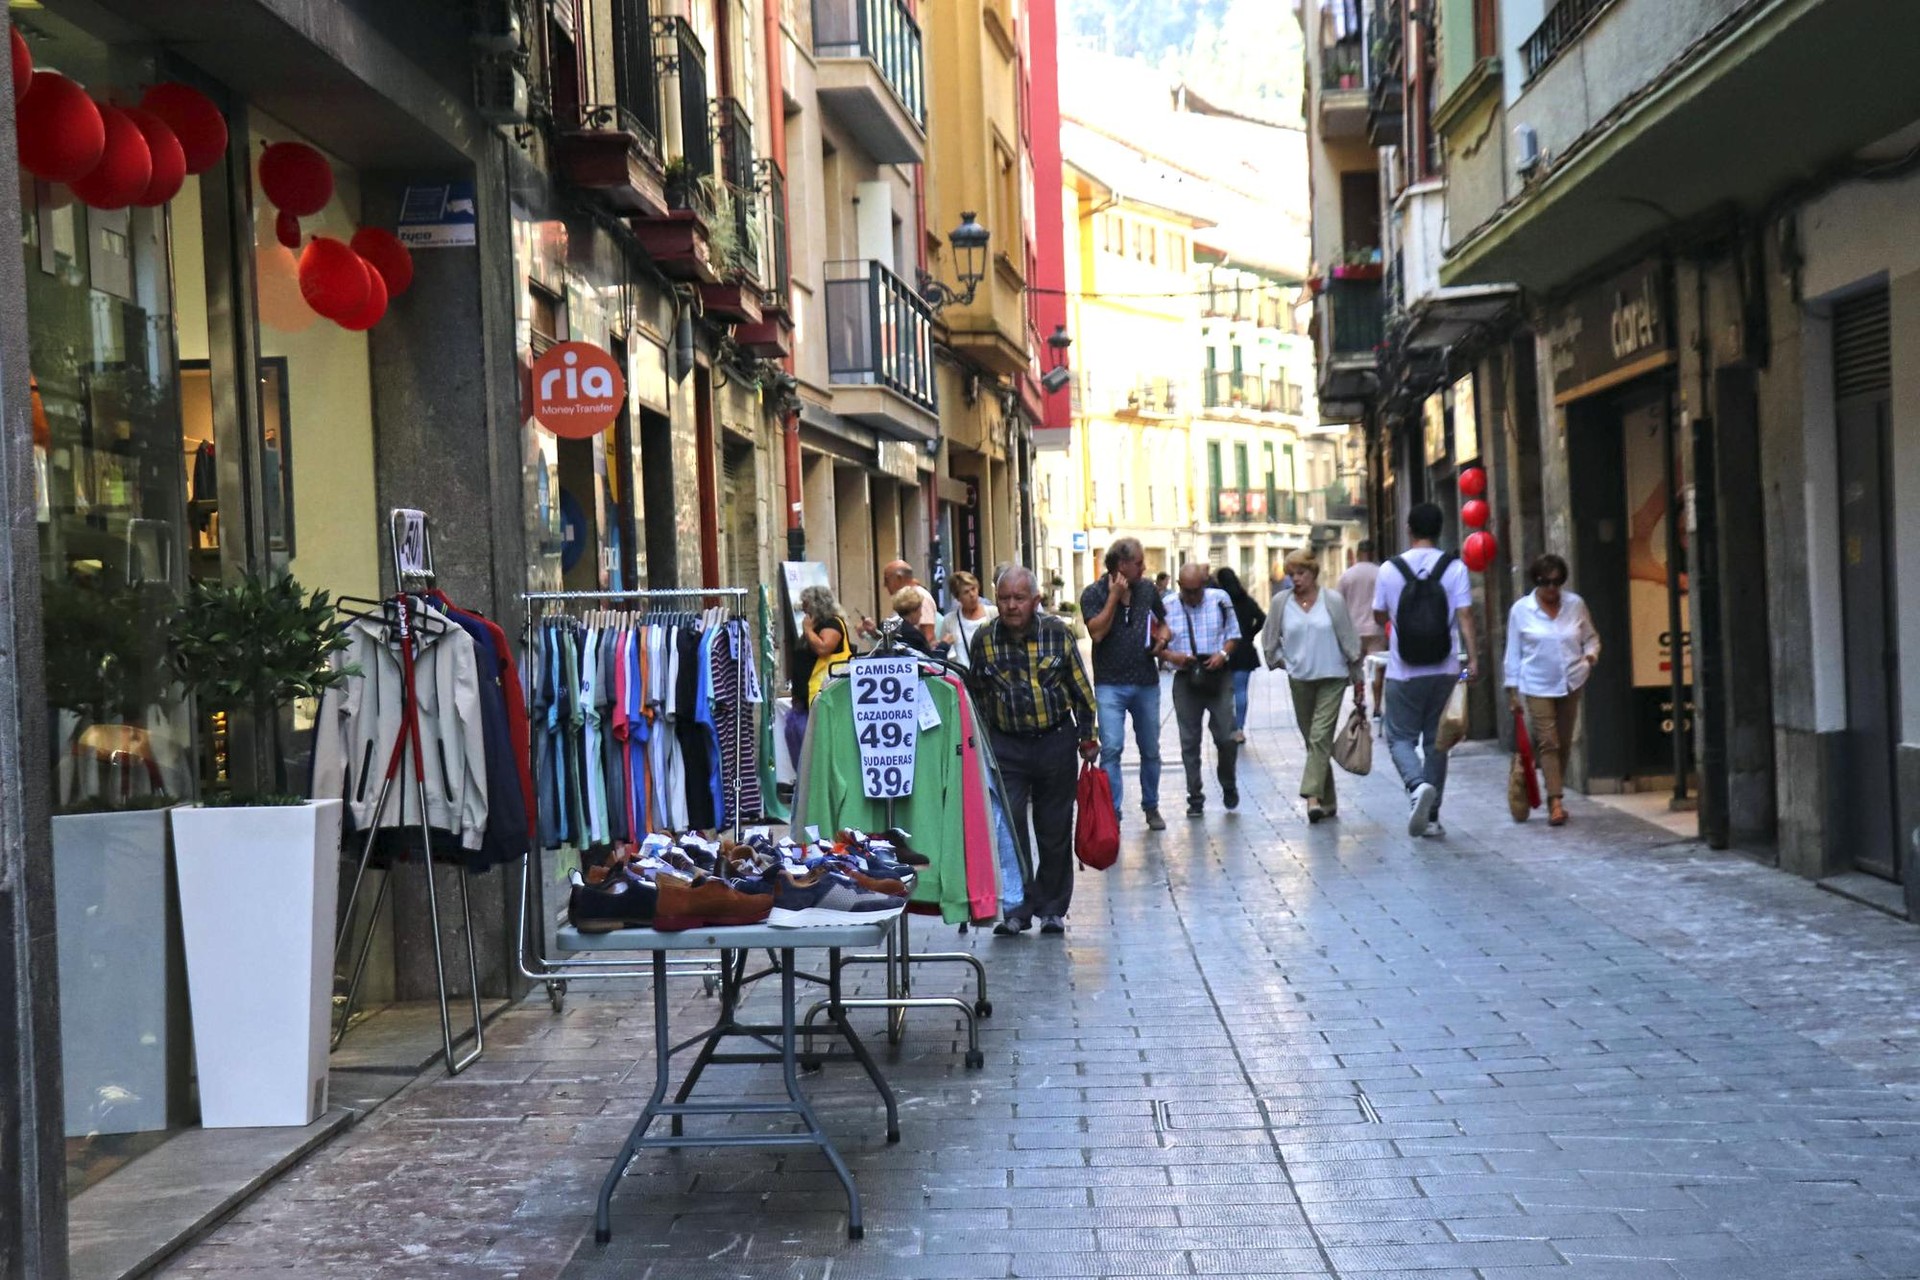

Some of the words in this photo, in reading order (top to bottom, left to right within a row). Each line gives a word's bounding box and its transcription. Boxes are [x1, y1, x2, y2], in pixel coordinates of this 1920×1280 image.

[541, 351, 613, 400] ria
[541, 405, 575, 415] Money
[576, 403, 614, 413] Transfer
[855, 663, 913, 676] CAMISAS
[857, 676, 915, 705] 29€
[857, 709, 913, 721] CAZADORAS
[860, 722, 913, 749] 49€
[863, 754, 913, 766] SUDADERAS
[866, 766, 911, 797] 39€
